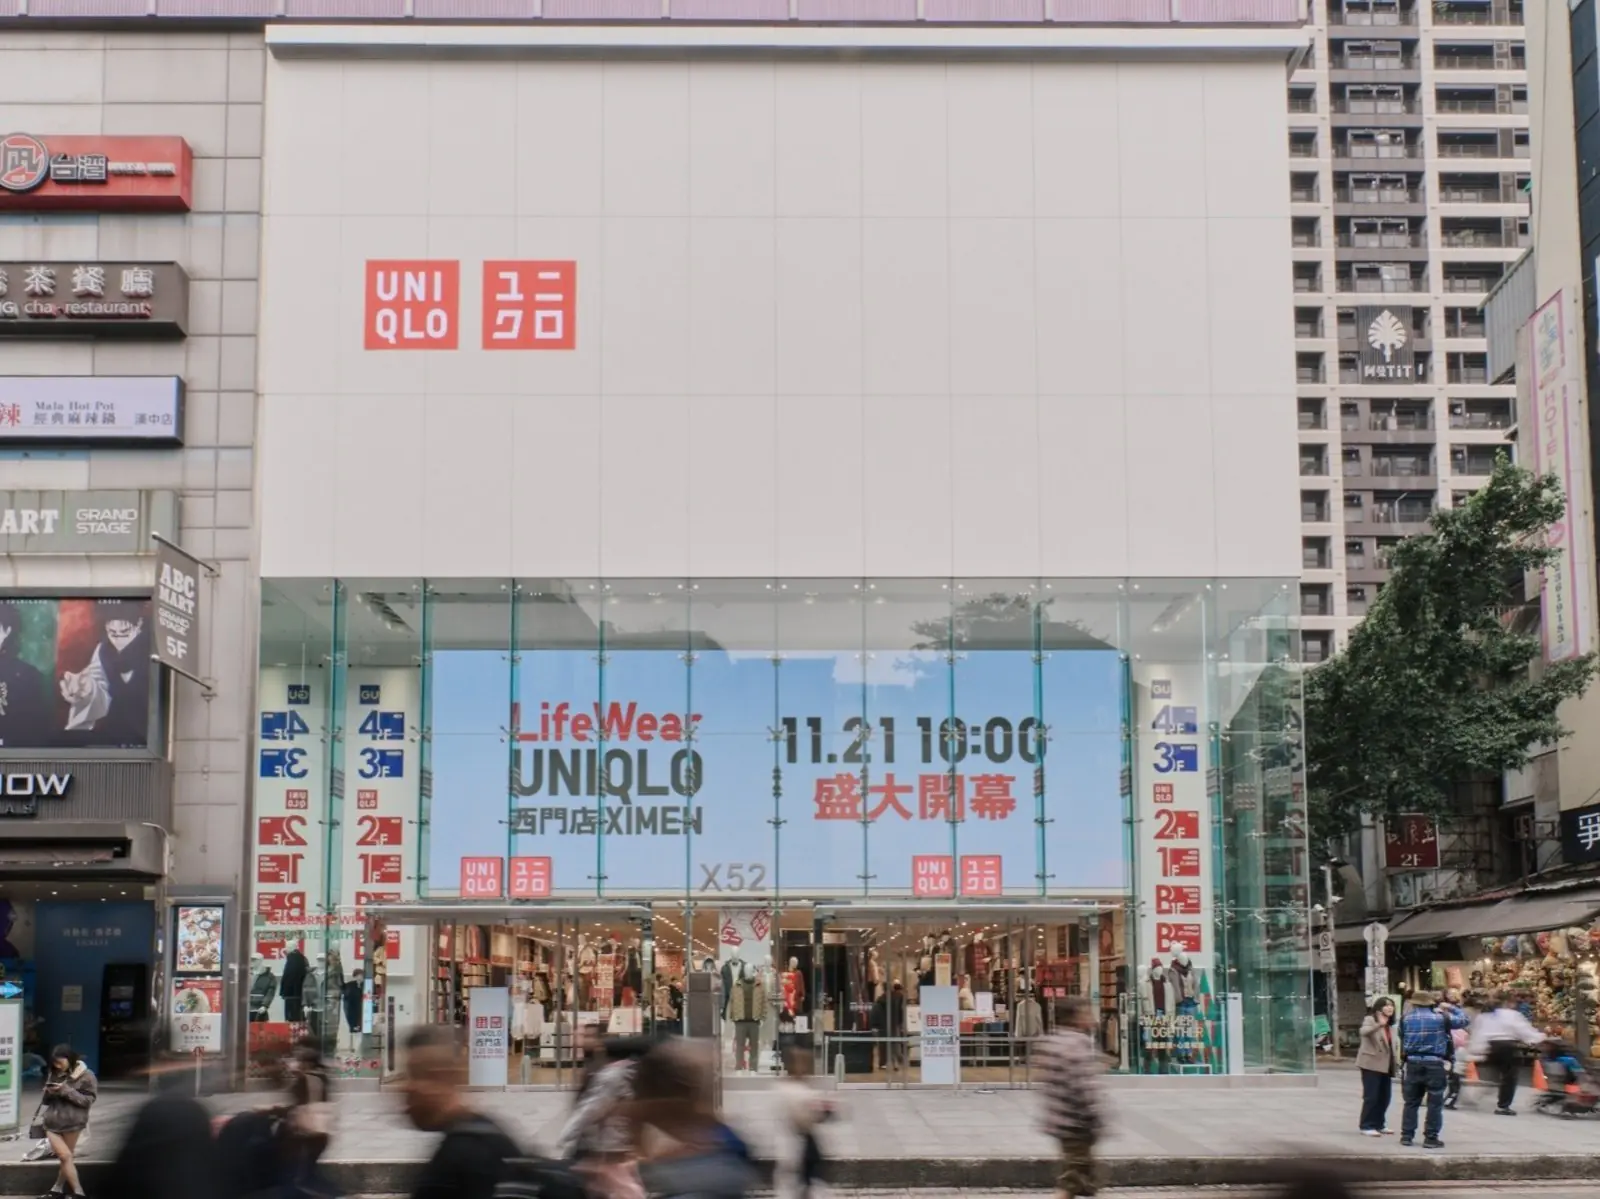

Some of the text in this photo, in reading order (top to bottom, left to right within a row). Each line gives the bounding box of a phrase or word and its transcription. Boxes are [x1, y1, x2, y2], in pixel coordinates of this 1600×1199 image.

[0, 266, 153, 295] 茶餐廳
[376, 271, 442, 302] UNI
[24, 301, 53, 314] cha
[65, 303, 148, 314] restaurant
[376, 308, 448, 344] QLO
[35, 402, 115, 411] Mala Hot Pot
[76, 508, 138, 521] GRAND
[76, 522, 131, 534] STAGE
[160, 562, 195, 598] ABC
[158, 585, 195, 615] MART
[166, 635, 188, 659] 5F
[510, 701, 702, 742] LifeWear
[782, 716, 1047, 764] 11.21 10:00
[0, 773, 71, 795] OW
[511, 748, 703, 805] UNIQLO
[813, 772, 1017, 821] 盛大開幕
[512, 806, 703, 835] 西門店 XIMEN
[466, 861, 495, 876] UNI
[700, 863, 767, 891] X52
[918, 861, 946, 874] UNI
[466, 878, 497, 893] QLO
[918, 878, 948, 892] QLO
